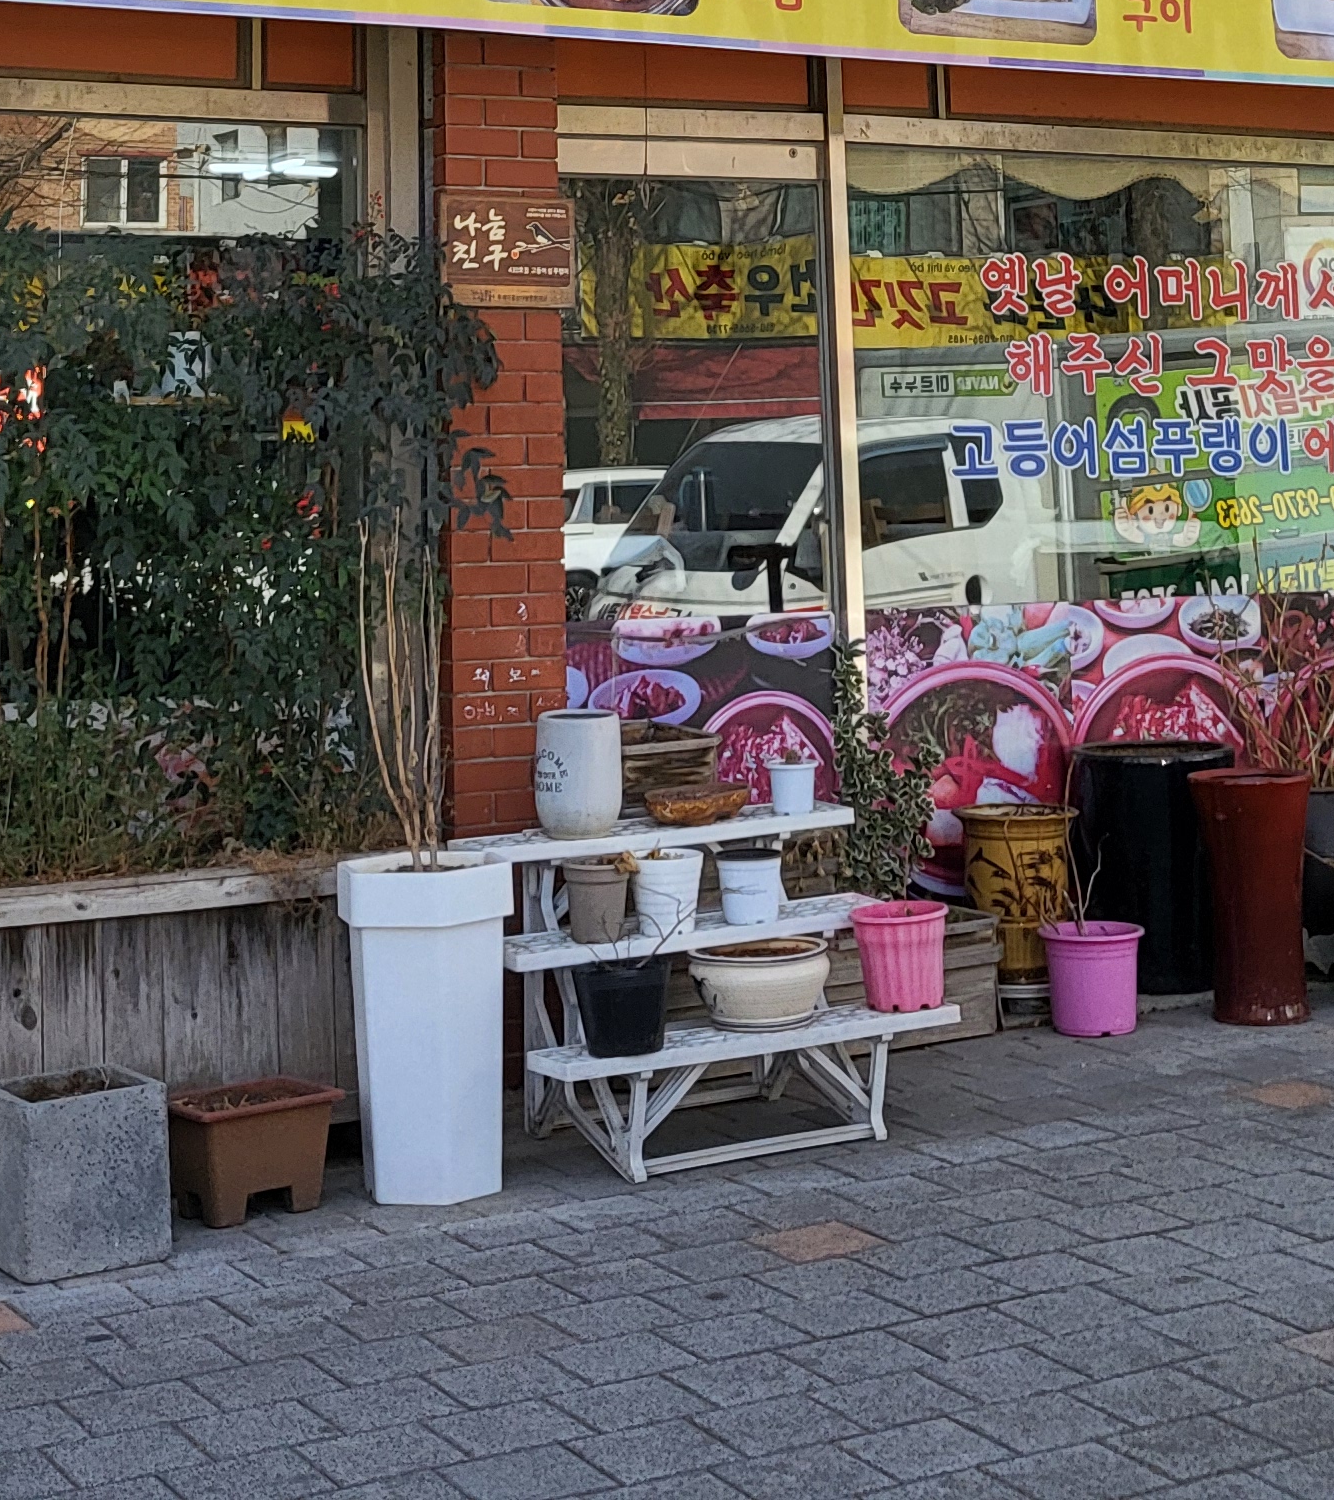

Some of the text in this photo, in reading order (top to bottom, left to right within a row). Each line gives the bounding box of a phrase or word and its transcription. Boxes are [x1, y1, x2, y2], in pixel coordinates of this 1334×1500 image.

[452, 239, 509, 272] 친구
[453, 207, 507, 242] 나눔
[978, 252, 1083, 321] 옛날
[1005, 334, 1164, 398] 해주신
[949, 416, 1293, 481] 고등어섬푸랭이
